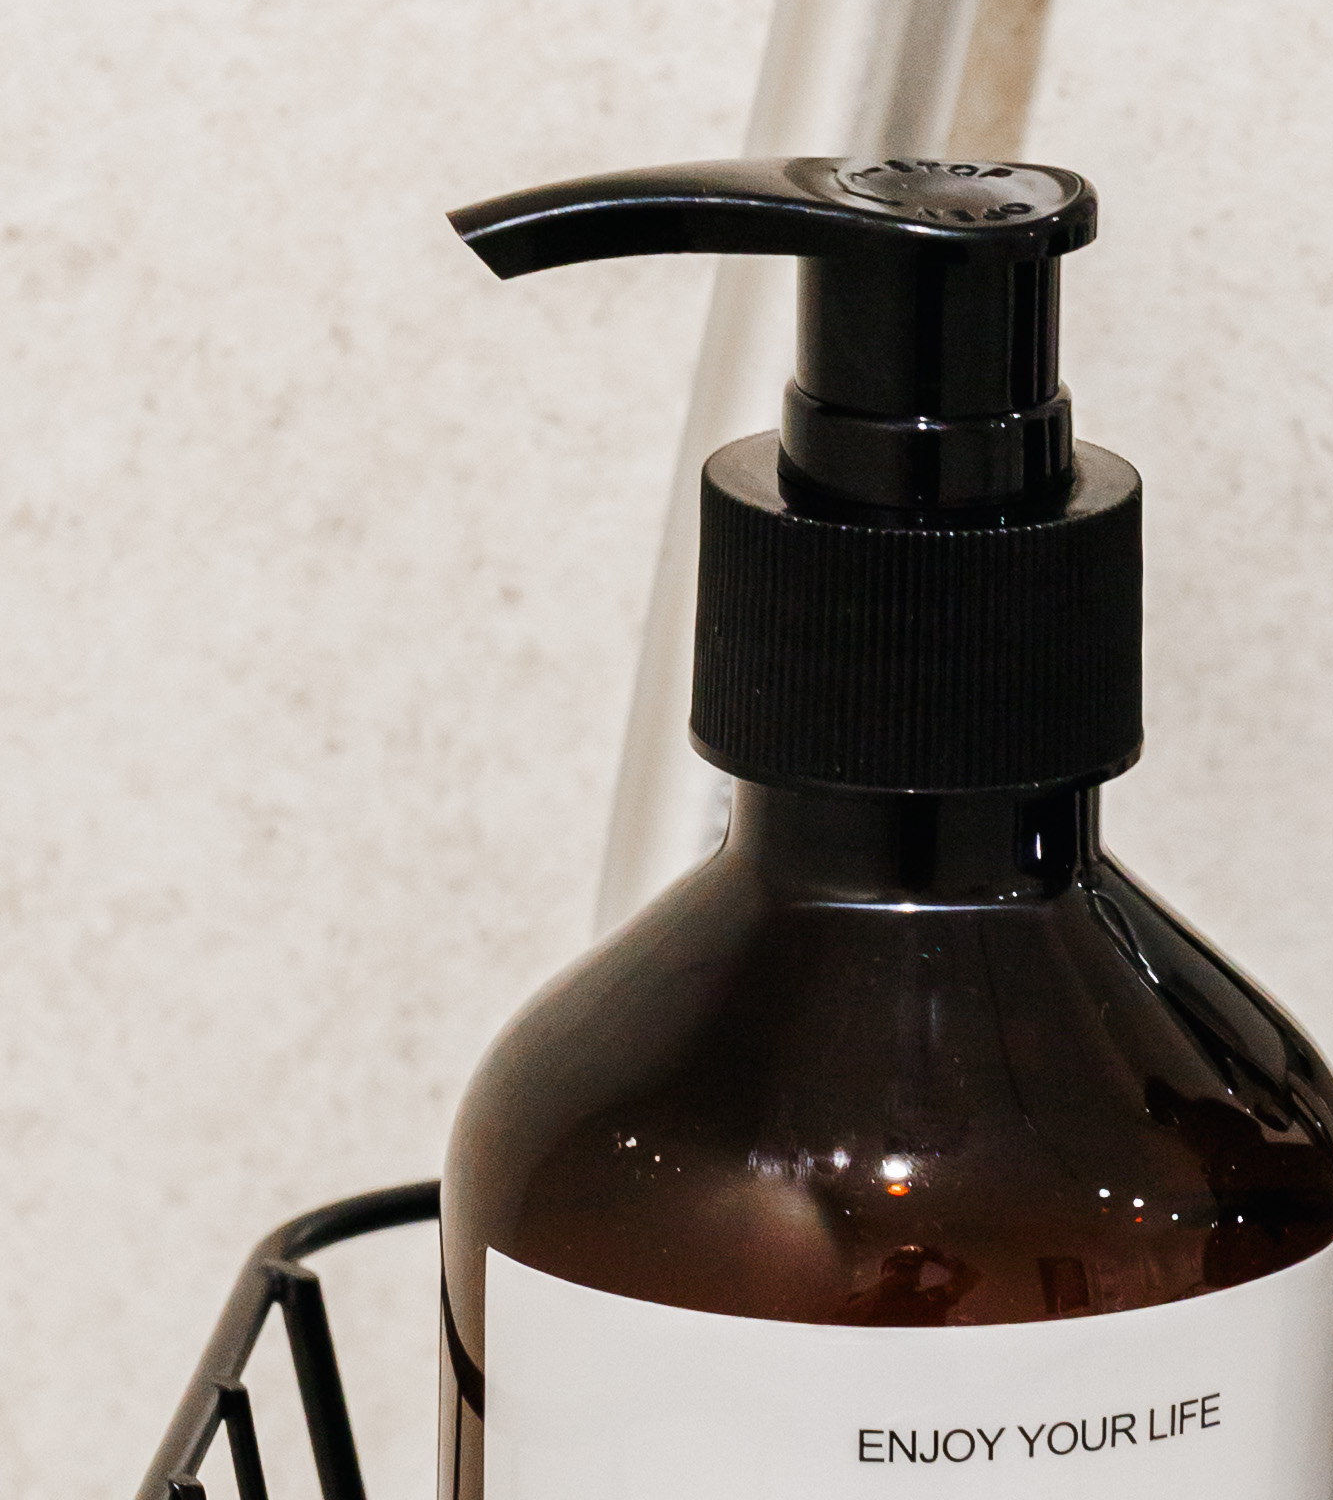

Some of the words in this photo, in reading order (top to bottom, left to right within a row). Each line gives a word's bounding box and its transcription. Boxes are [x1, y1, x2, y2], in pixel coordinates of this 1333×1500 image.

[858, 1427, 1006, 1464] ENJOY
[1017, 1413, 1137, 1458] YOUR
[1149, 1392, 1221, 1441] LIFE
